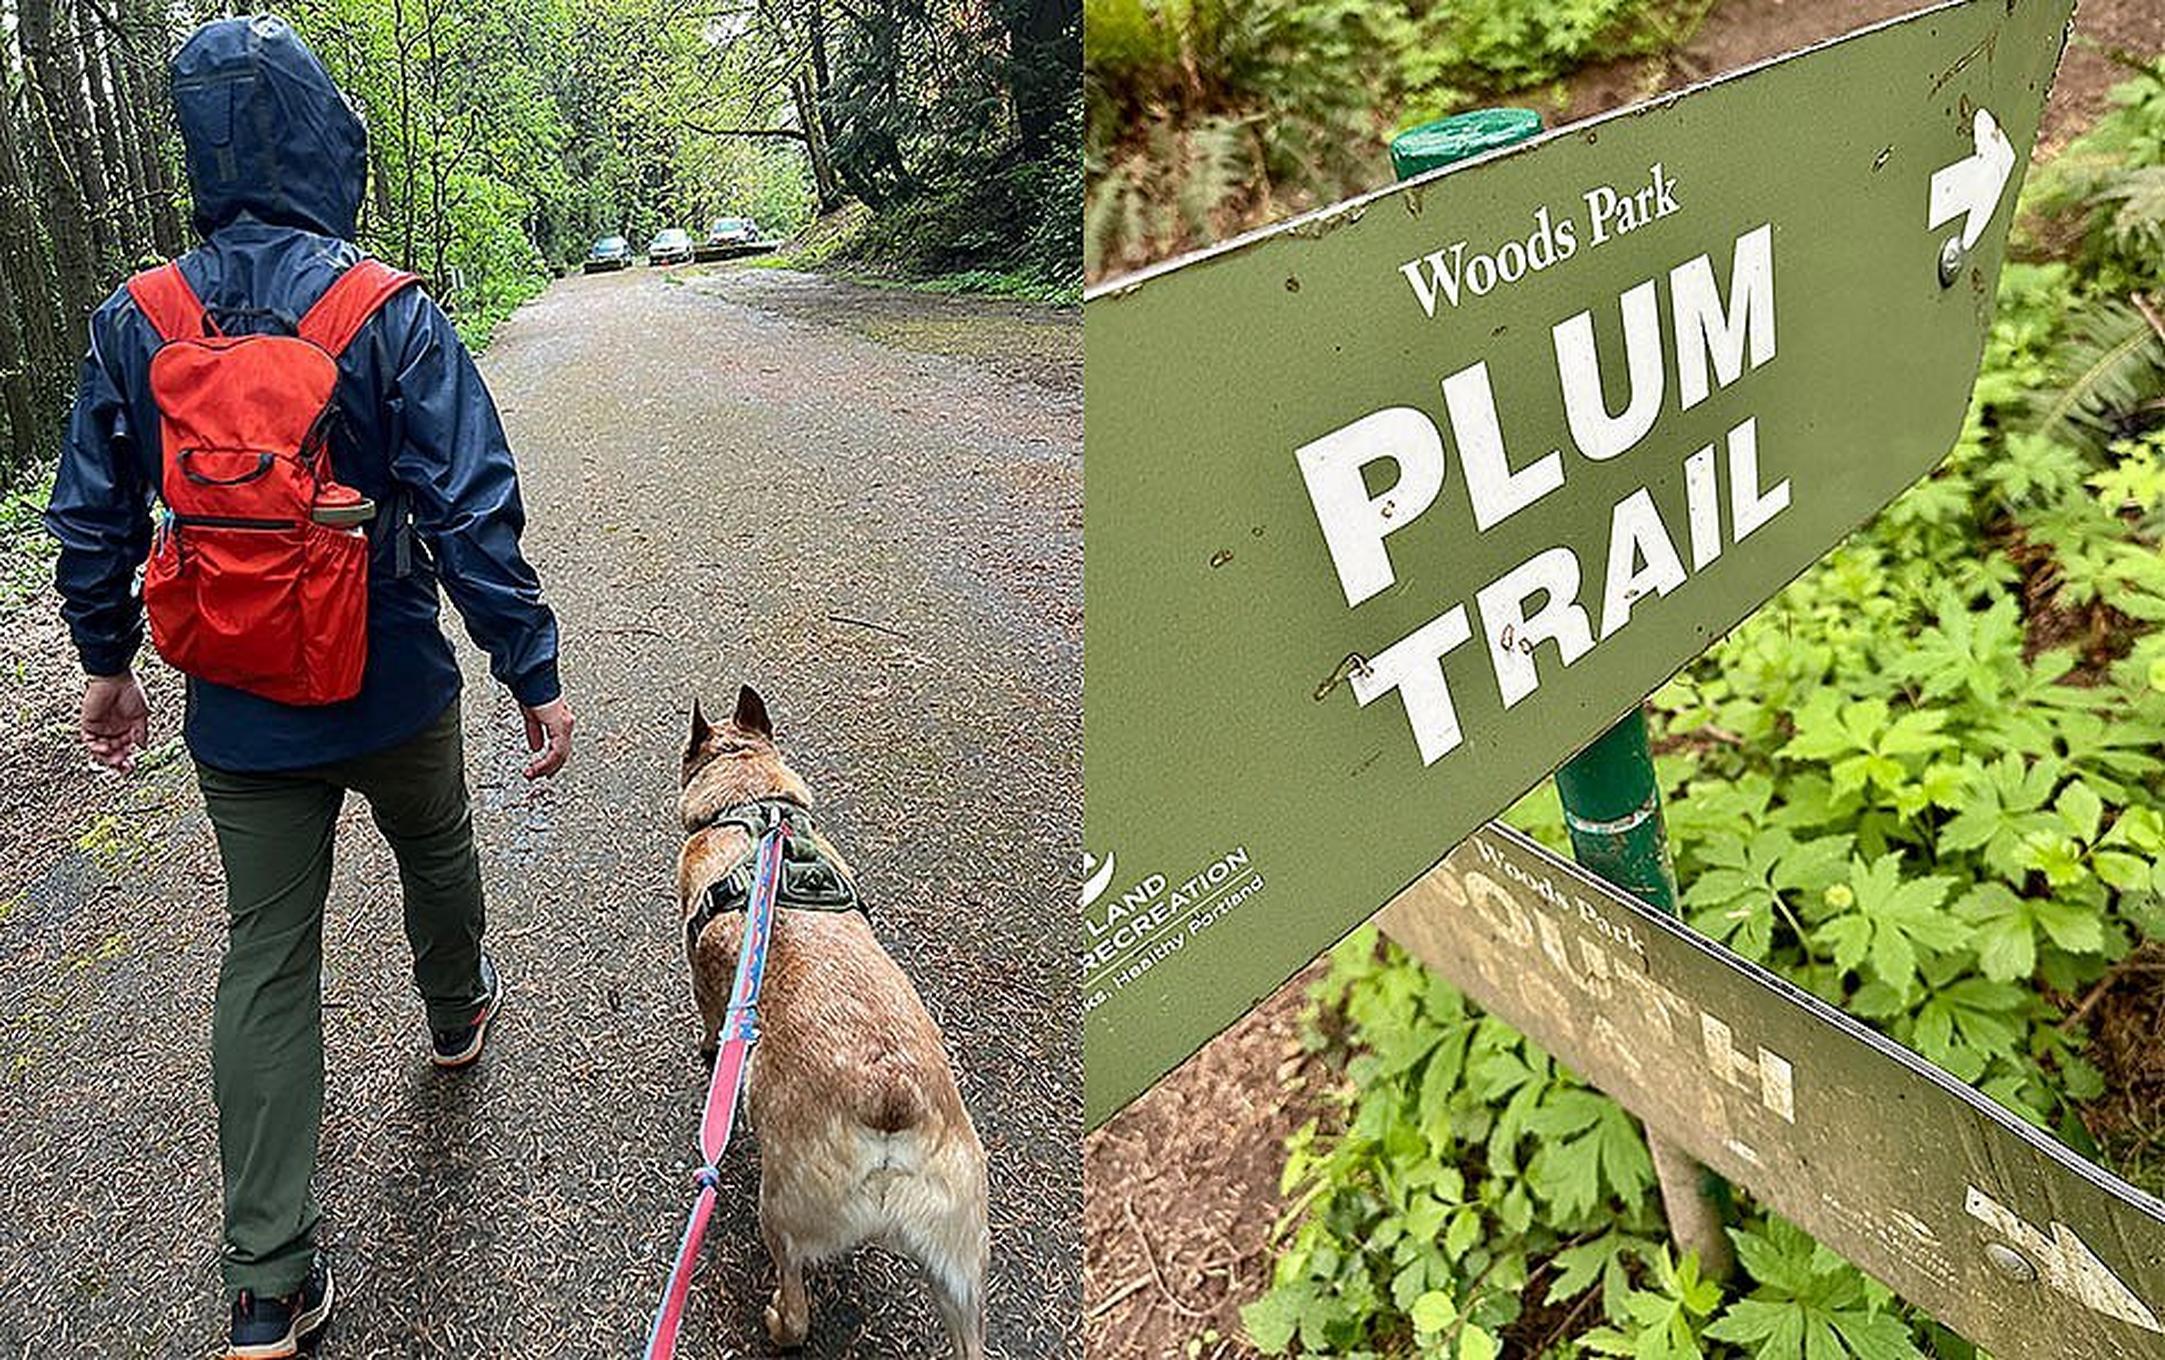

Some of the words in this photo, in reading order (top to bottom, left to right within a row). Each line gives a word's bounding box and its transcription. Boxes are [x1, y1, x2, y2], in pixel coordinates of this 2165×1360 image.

[1399, 206, 1577, 318] Woods
[1583, 163, 1680, 247] Park
[1294, 223, 1777, 608] PLUM
[1347, 416, 1791, 767] TRAIL
[1082, 846, 1250, 978] RECREATION
[1085, 873, 1167, 938] LAND
[1112, 932, 1185, 989] Healthy
[1188, 873, 1265, 936] Portland
[1471, 836, 1569, 910] Woods
[1574, 896, 1646, 956] Park
